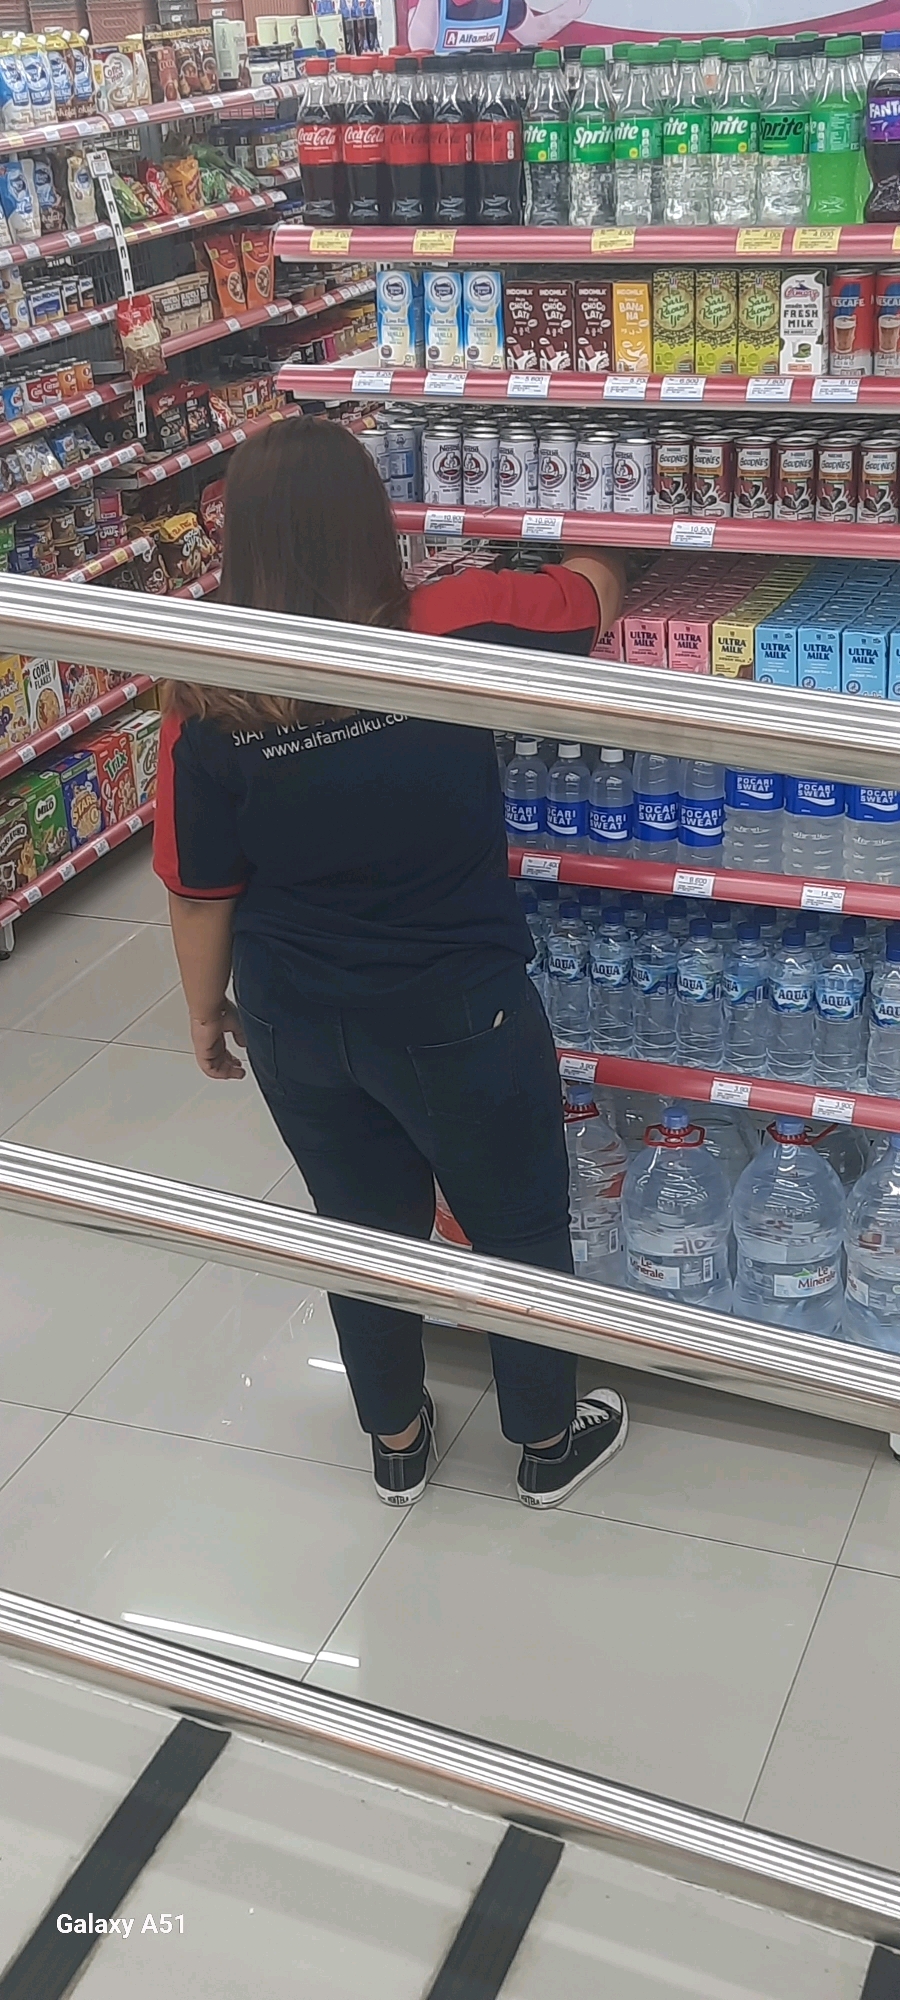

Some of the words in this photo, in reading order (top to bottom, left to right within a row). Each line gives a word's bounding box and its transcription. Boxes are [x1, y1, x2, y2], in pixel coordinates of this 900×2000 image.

[784, 309, 818, 318] FRESH
[788, 319, 813, 328] MILK
[630, 631, 658, 640] ULTRA
[674, 633, 702, 643] ULTRA
[634, 639, 655, 648] MILK
[677, 641, 699, 650] MILK
[718, 637, 746, 648] ULTRA
[761, 643, 791, 652] ULTRA
[721, 645, 743, 655] MILK
[803, 644, 833, 653] ULTRA
[848, 647, 879, 657] ULTRA
[764, 650, 787, 659] MILK
[807, 651, 830, 661] MILK
[852, 656, 875, 665] MILK
[33, 660, 50, 680] CORN
[737, 777, 773, 786] POCARI
[737, 783, 769, 792] SWEAT
[798, 783, 835, 793] POCARI
[798, 789, 831, 799] SWEAT
[860, 789, 897, 799] POCARI
[860, 795, 894, 804] SWEAT
[37, 799, 55, 818] MILO
[639, 803, 678, 815] POCARI
[681, 808, 721, 819] POCARI
[590, 811, 627, 823] POCARI
[639, 811, 676, 822] SWEAT
[681, 816, 718, 827] SWEAT
[590, 819, 622, 831] SWEAT
[550, 956, 576, 971] AQUA
[593, 963, 620, 977] AQUA
[678, 976, 704, 991] AQUA
[778, 988, 808, 1002] AQUA
[821, 996, 851, 1007] AQUA
[641, 1256, 653, 1269] Le
[817, 1266, 829, 1277] Le
[798, 1270, 836, 1289] Minerale
